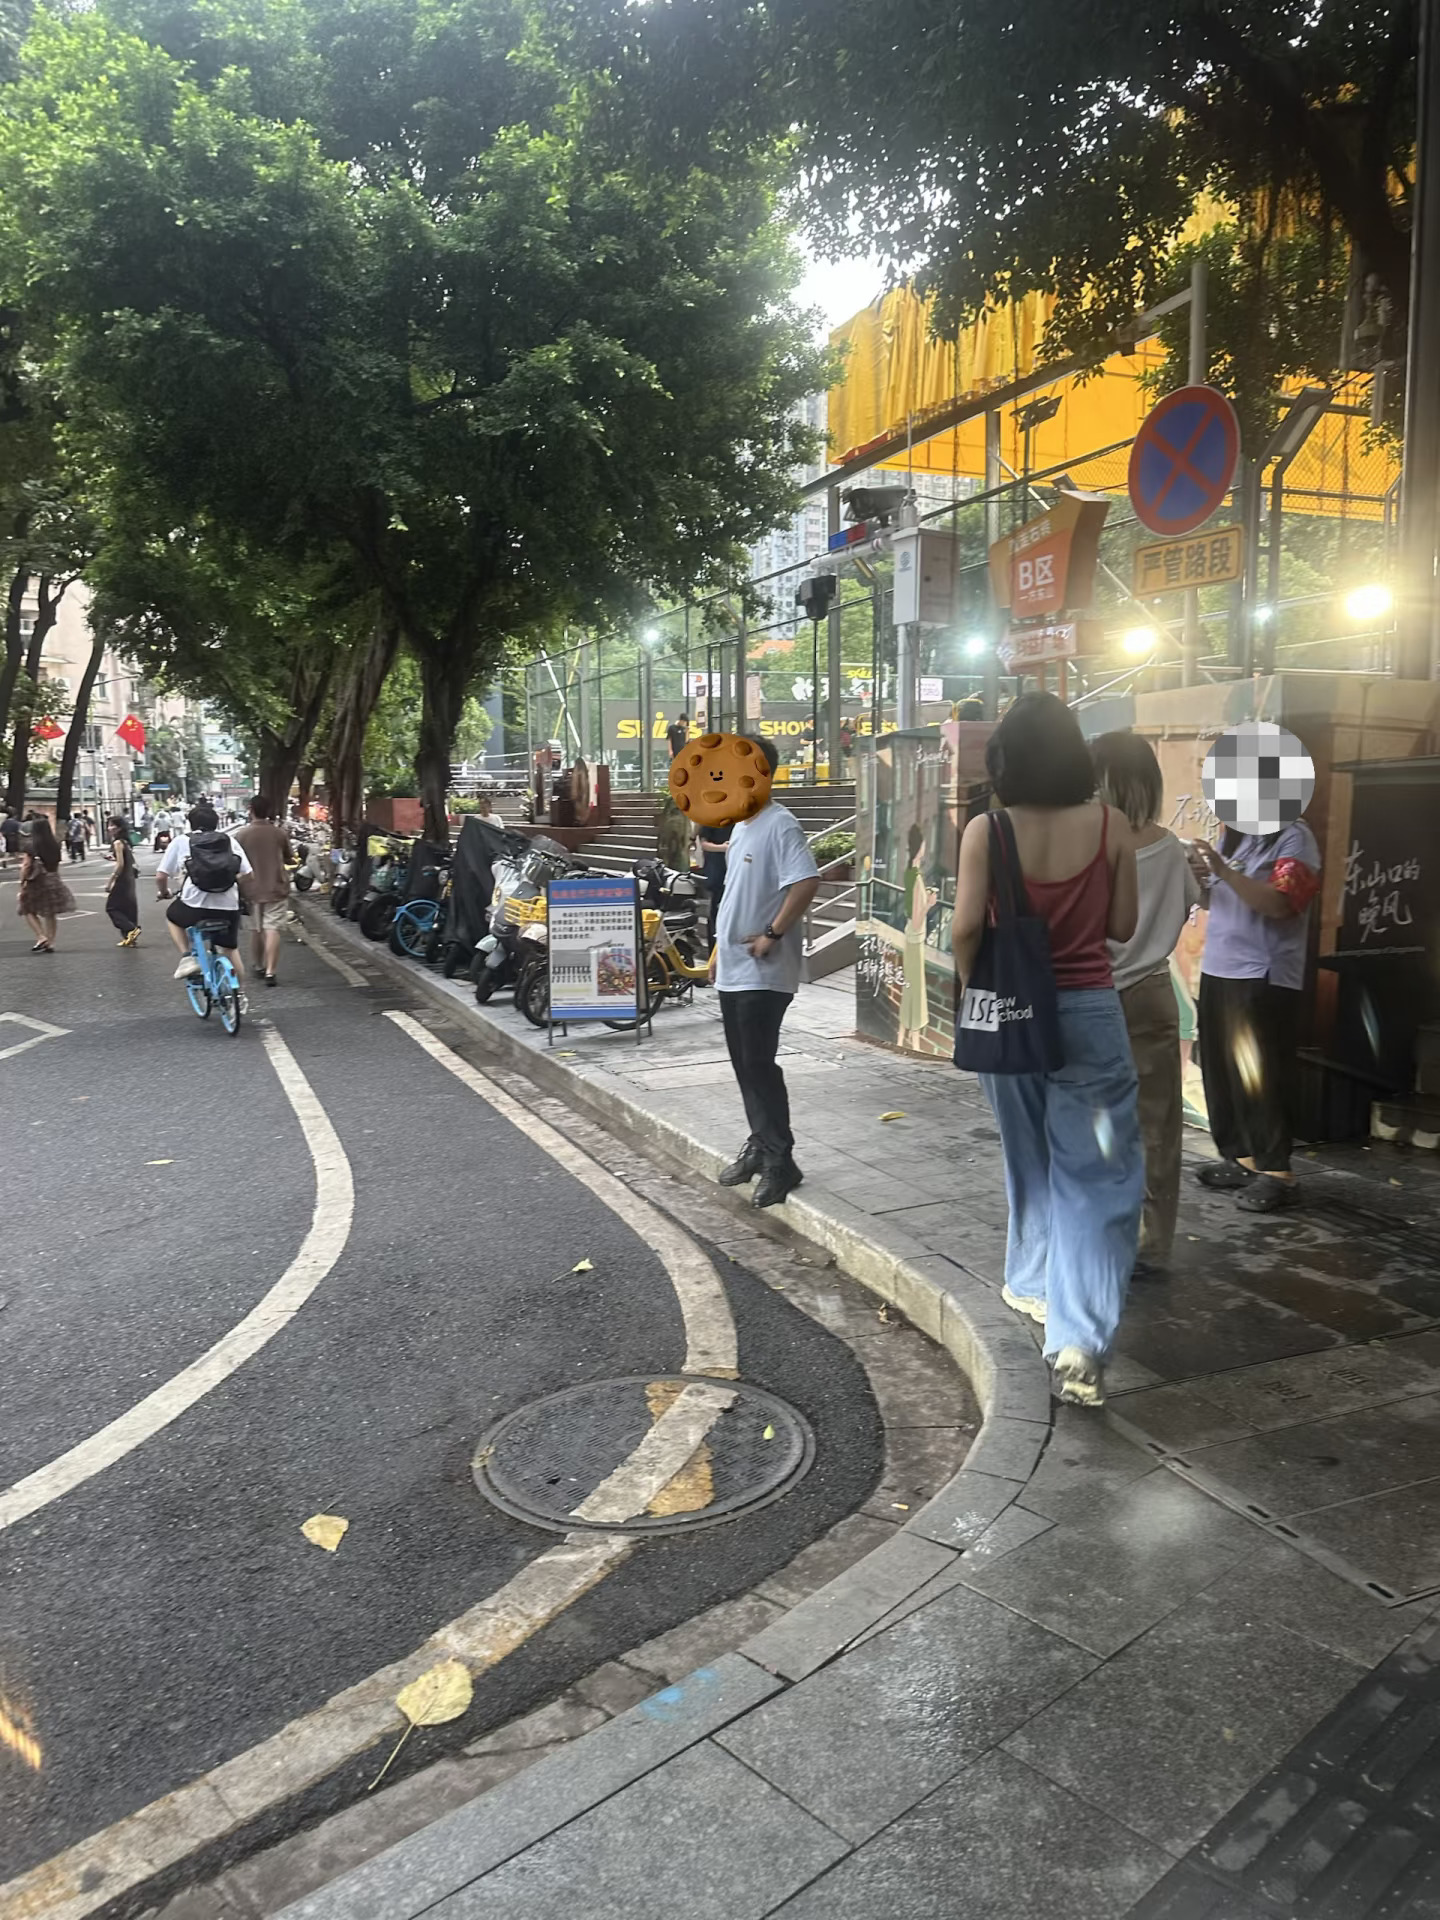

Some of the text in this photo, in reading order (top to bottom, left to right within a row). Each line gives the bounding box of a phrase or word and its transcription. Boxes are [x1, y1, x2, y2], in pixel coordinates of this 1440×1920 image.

[1018, 554, 1055, 591] B区
[1141, 536, 1231, 589] 严管路段
[1358, 888, 1413, 943] 晚风
[969, 996, 997, 1024] LSE
